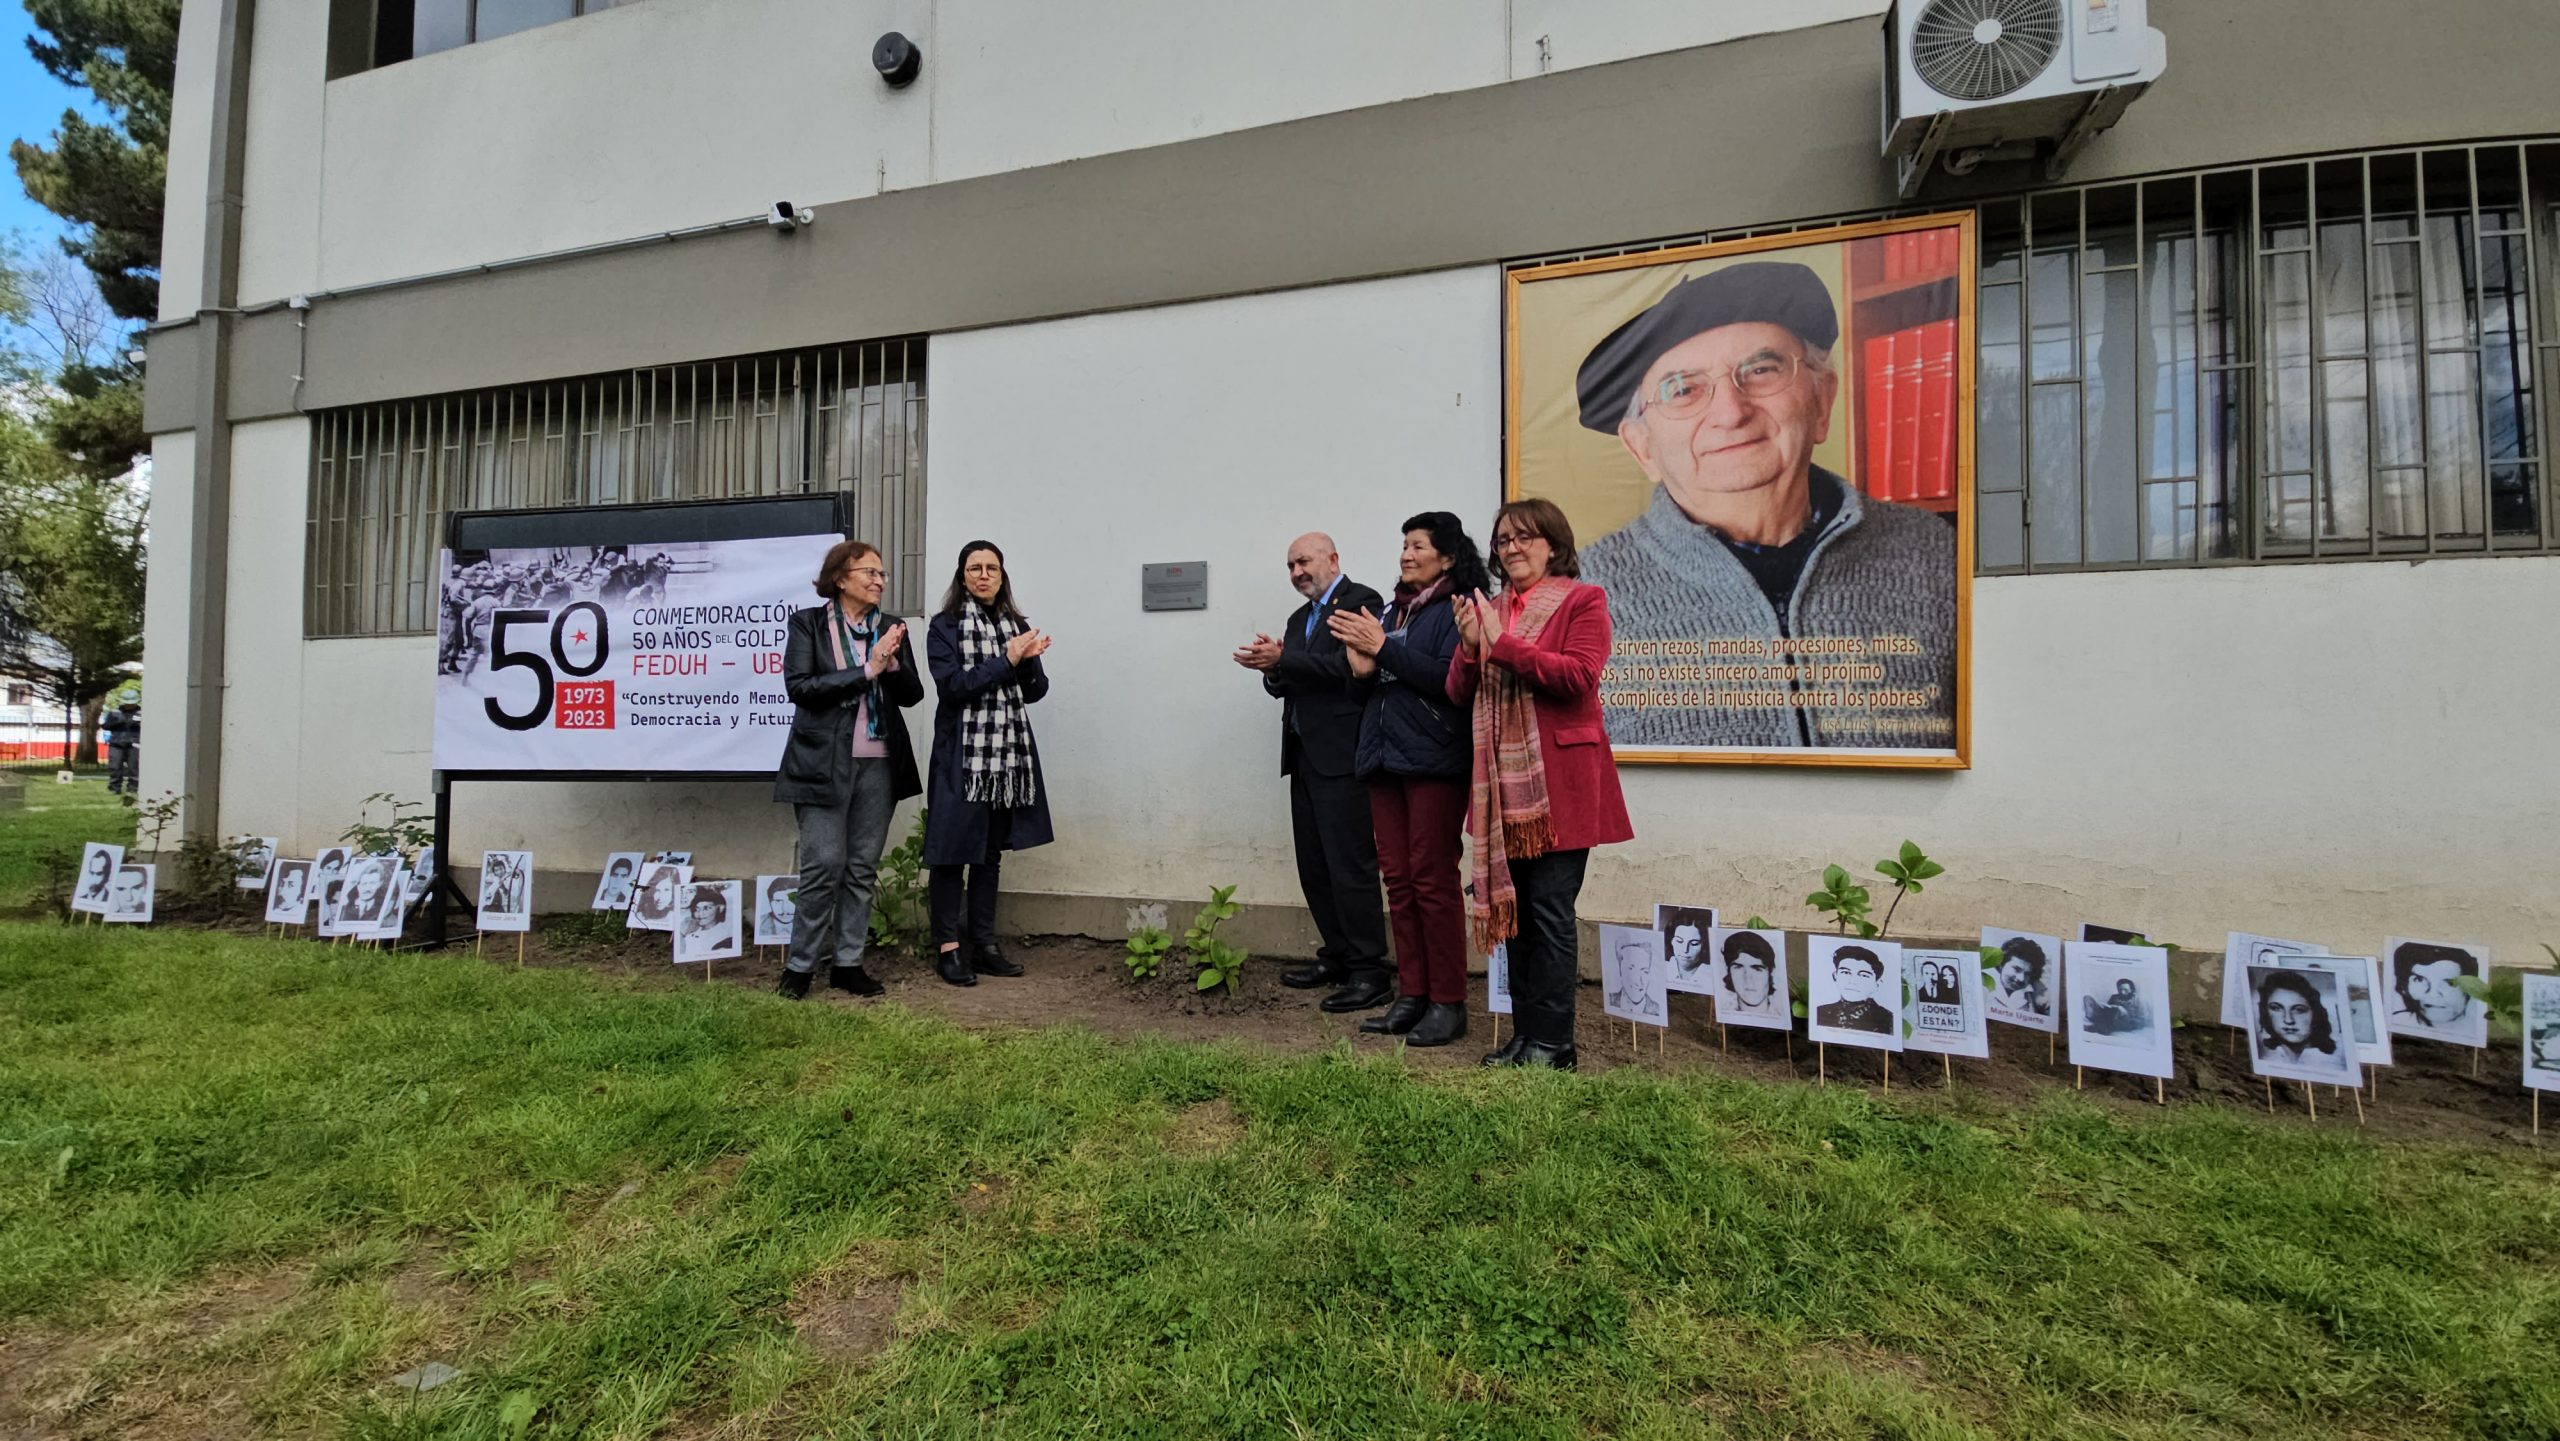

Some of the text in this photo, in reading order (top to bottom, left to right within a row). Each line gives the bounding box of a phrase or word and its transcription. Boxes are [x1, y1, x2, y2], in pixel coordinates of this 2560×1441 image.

[632, 626, 786, 650] 50 AÑOS DEL GOLP
[1616, 637, 1658, 656] sirven
[1662, 639, 1704, 657] rezos,
[1708, 635, 1767, 658] mandas,
[1772, 635, 1867, 659] procesiones,
[1872, 634, 1921, 655] misas,
[484, 601, 610, 731] 50
[632, 654, 708, 676] FEDUH
[752, 653, 784, 675] UB
[1600, 660, 1882, 685] os, si no existe sincero amor al prójimo
[563, 687, 606, 705] 1973
[622, 690, 740, 709] “Construyendo
[1609, 685, 1678, 711] cómplices
[1682, 687, 1699, 706] de
[1703, 687, 1715, 706] la
[1720, 686, 1784, 711] injusticia
[1789, 689, 1838, 707] contra
[1843, 687, 1865, 707] los
[563, 709, 606, 727] 2023
[630, 711, 795, 729] Democracia y Futur
[1989, 1006, 2046, 1025] Marta Ugarte
